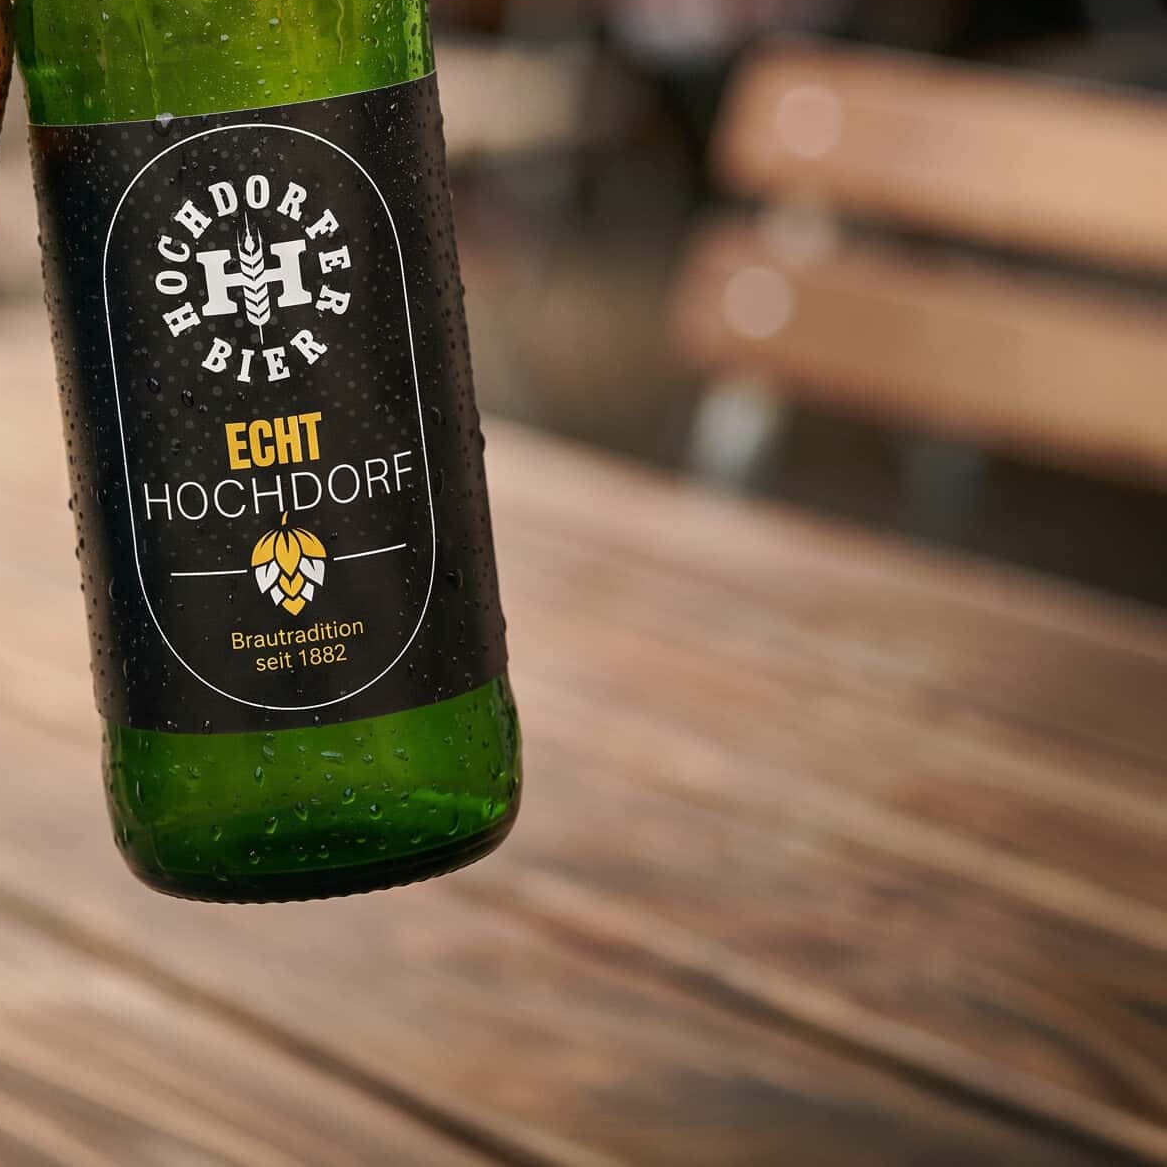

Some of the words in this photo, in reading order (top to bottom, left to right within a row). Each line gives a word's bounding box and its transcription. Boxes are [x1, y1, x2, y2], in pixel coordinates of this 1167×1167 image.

[154, 174, 351, 338] HOCHDORFER
[195, 239, 313, 316] H
[202, 328, 328, 383] BIER
[225, 412, 322, 470] ECHT
[143, 451, 413, 521] HOCHDORF
[231, 618, 364, 650] Brautradition
[256, 649, 292, 670] seit
[298, 644, 347, 666] 1882
